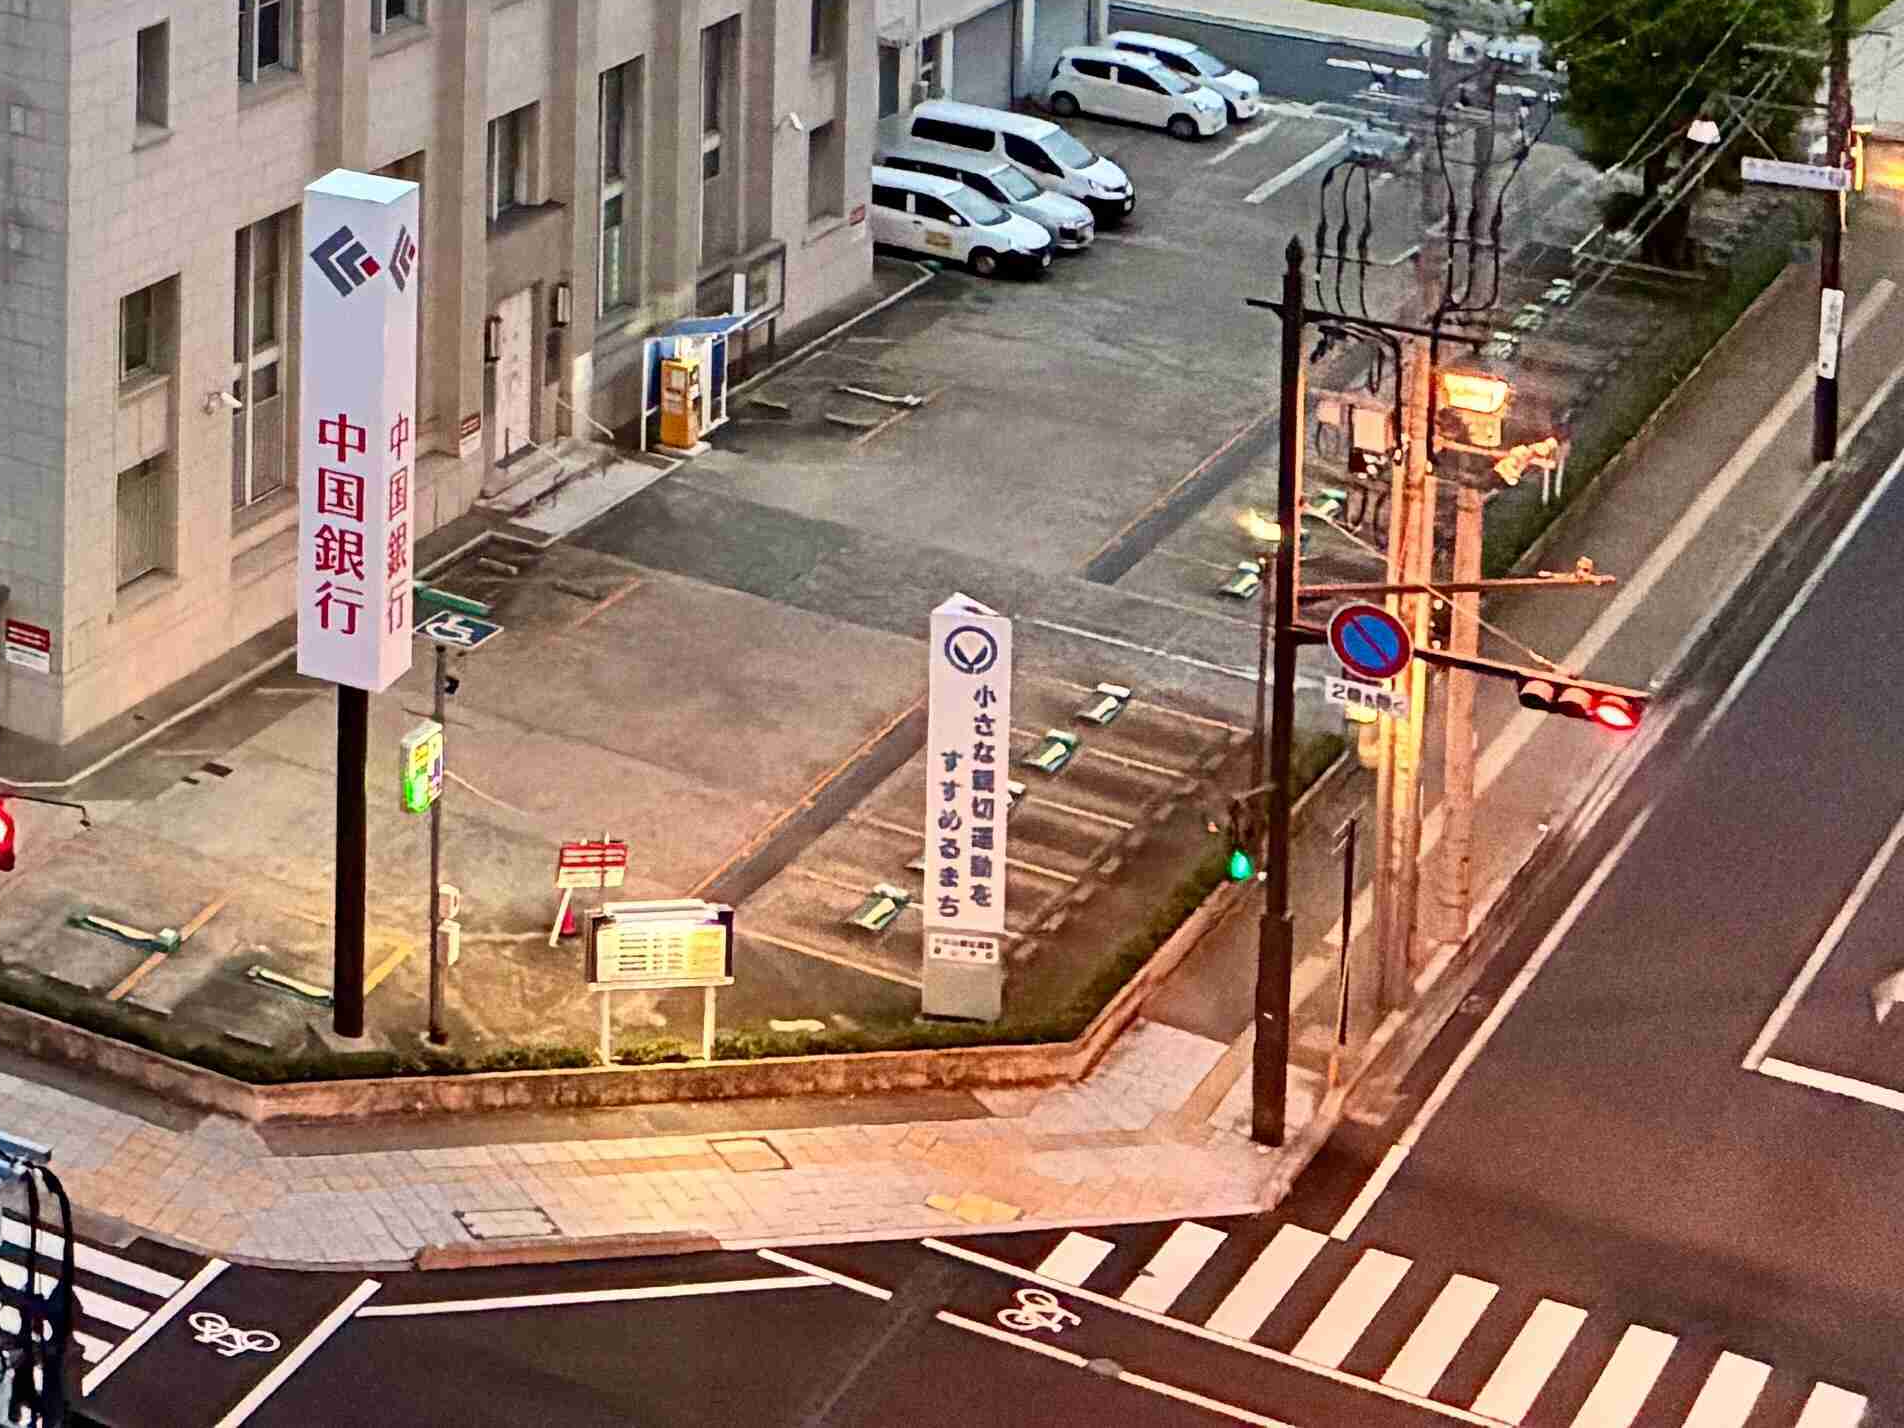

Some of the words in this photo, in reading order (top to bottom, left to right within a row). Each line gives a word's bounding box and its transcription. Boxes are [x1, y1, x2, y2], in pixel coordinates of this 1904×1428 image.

[314, 413, 367, 636] 中国銀行
[386, 412, 410, 636] 中国銀行
[938, 749, 964, 919] すすめるまち
